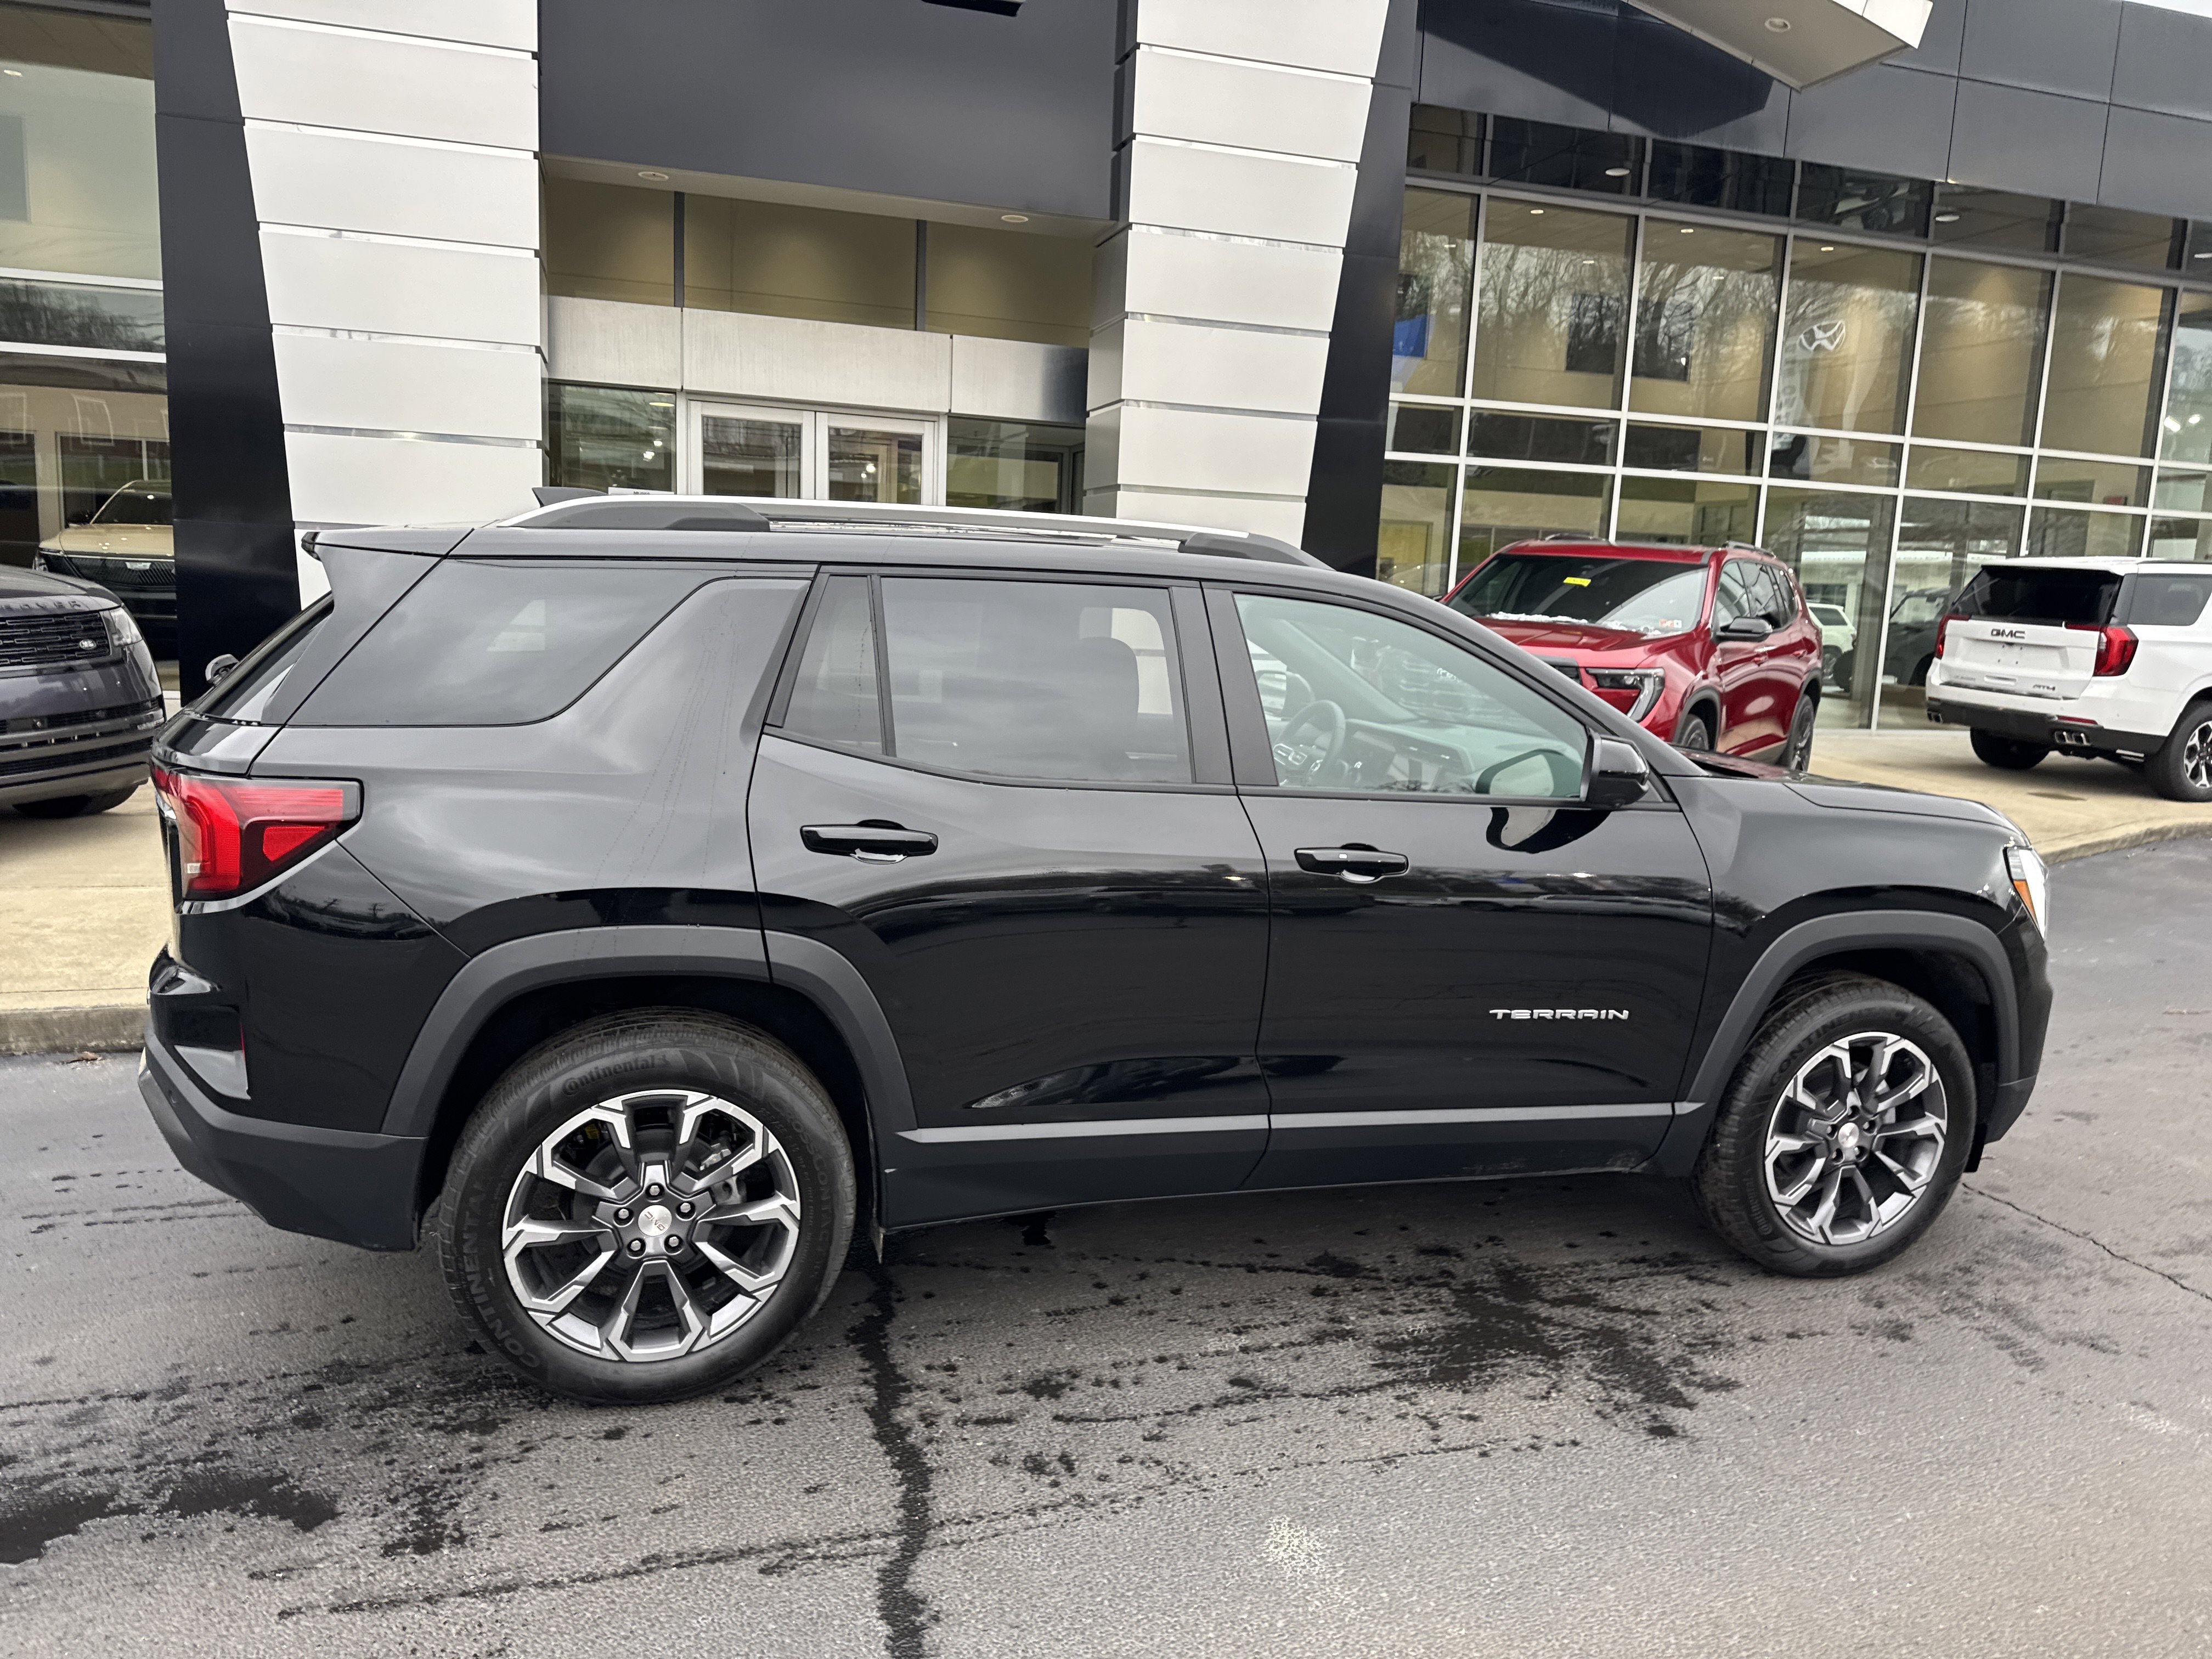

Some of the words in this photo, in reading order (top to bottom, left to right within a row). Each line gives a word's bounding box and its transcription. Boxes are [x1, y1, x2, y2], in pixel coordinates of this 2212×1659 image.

[1991, 629, 2025, 639] GMC
[1489, 1009, 1629, 1020] TERRAIN
[562, 1054, 656, 1096] Continental
[644, 1211, 665, 1231] GMC
